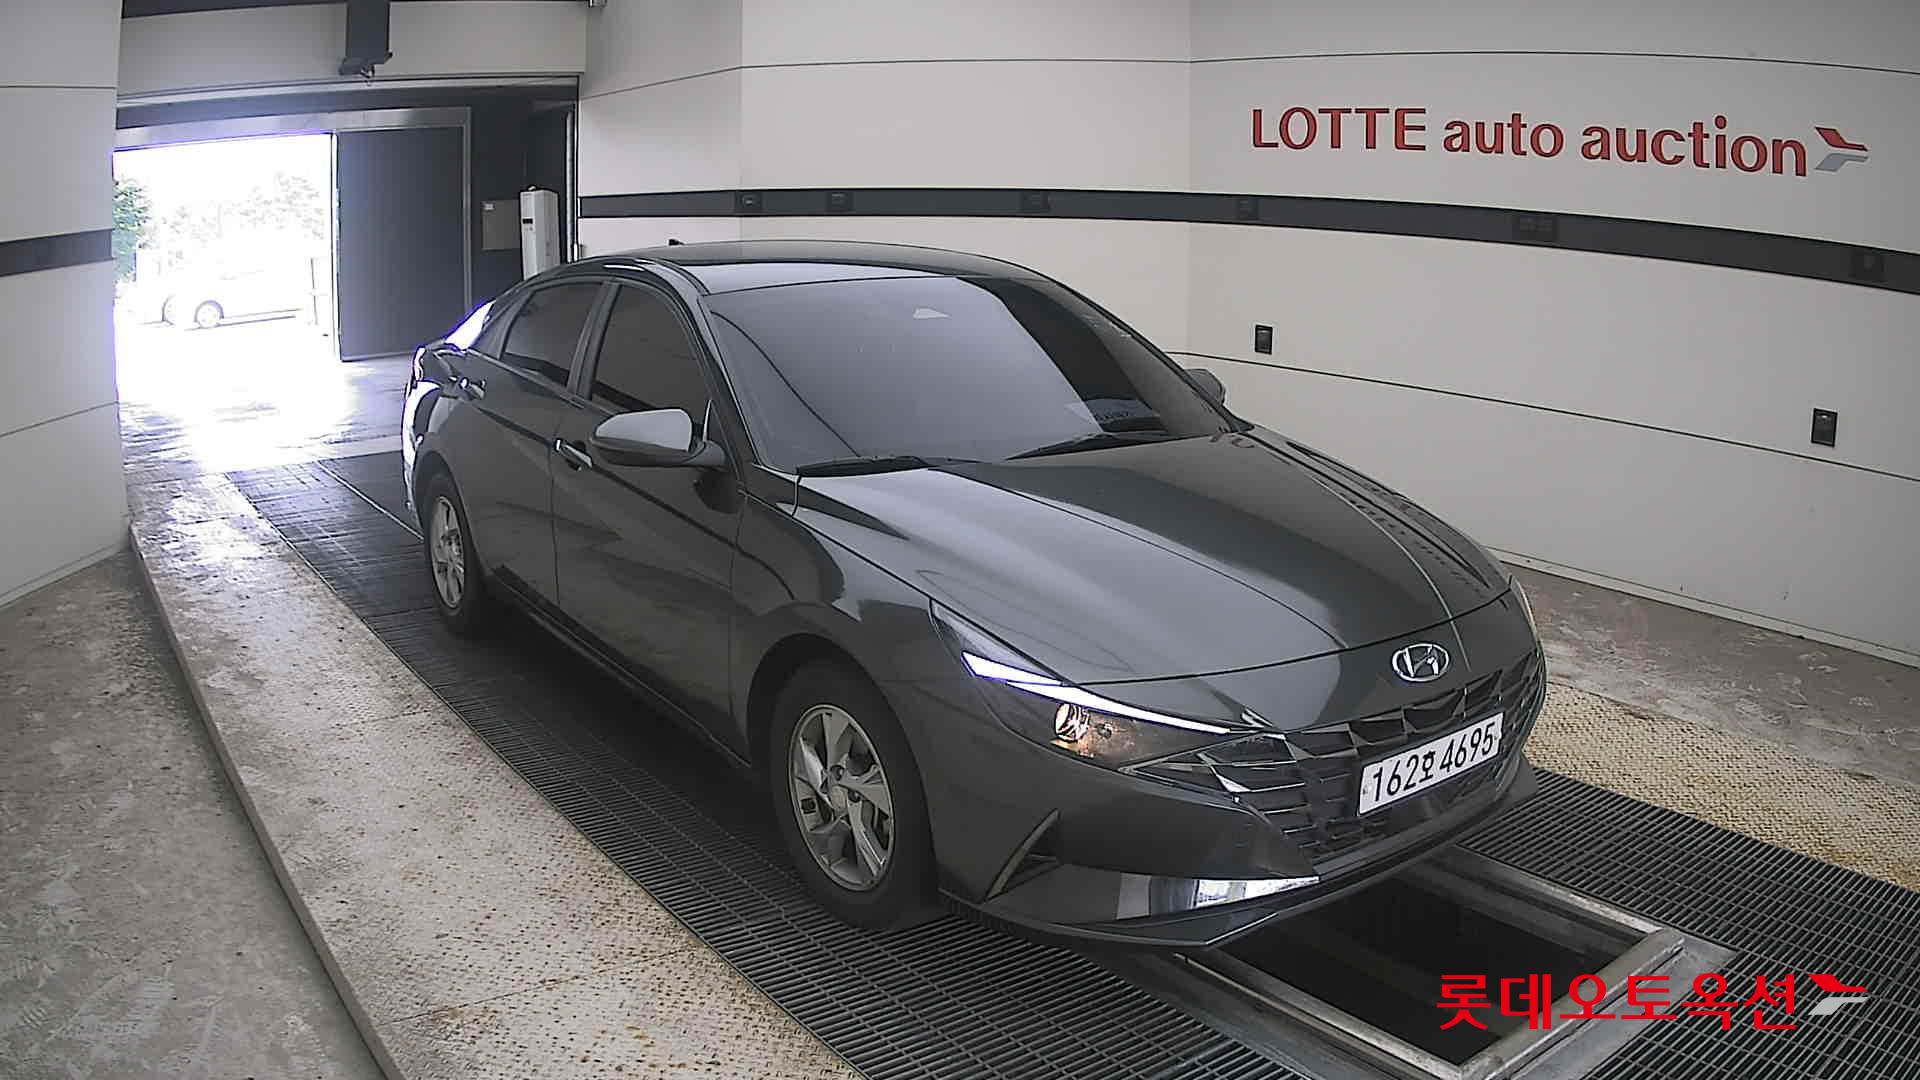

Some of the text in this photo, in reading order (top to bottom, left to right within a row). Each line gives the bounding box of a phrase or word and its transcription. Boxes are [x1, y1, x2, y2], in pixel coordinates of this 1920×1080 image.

[1251, 107, 1808, 177] LOTTE auto auction
